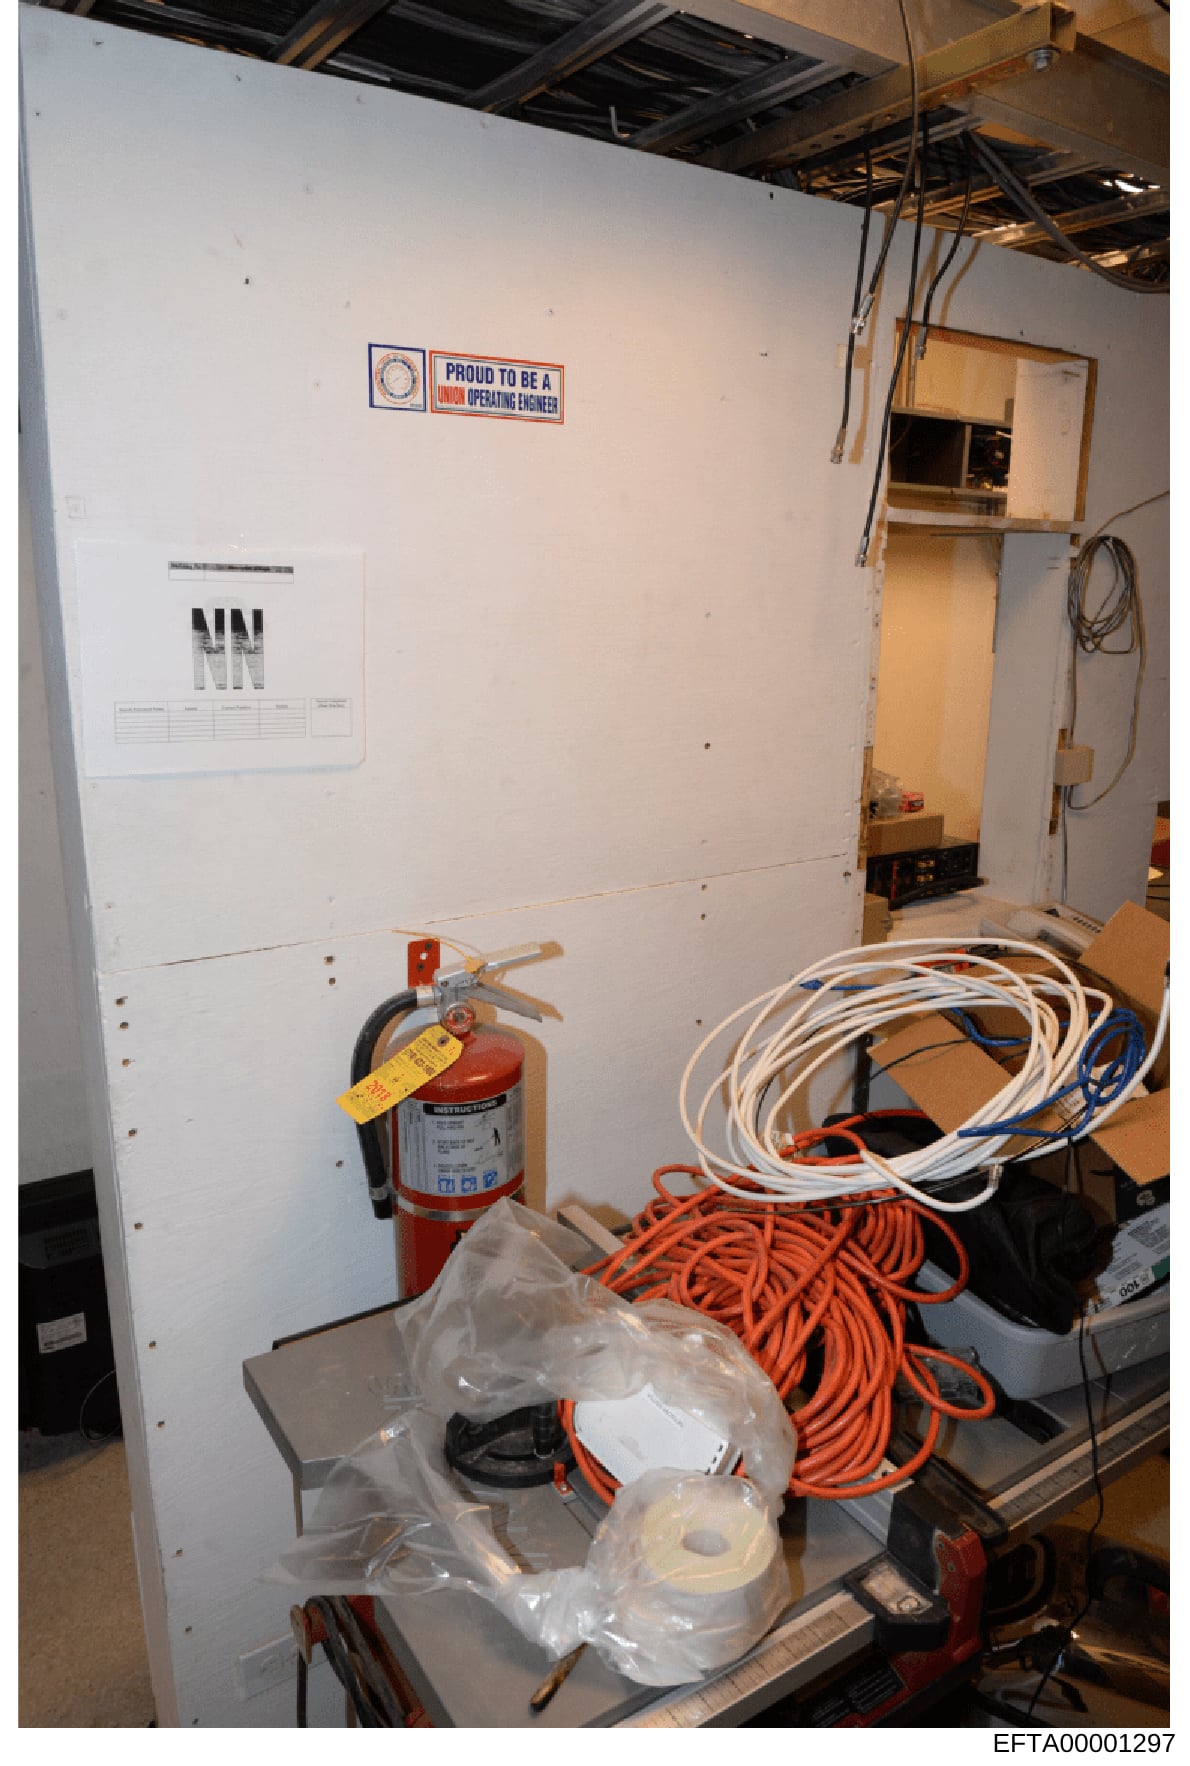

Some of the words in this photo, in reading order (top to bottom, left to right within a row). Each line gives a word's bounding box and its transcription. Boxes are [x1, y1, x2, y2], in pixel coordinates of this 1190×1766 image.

[446, 362, 494, 384] PROUD
[499, 368, 516, 387] TO
[521, 370, 538, 389] BE
[542, 373, 551, 390] A
[438, 385, 465, 405] UNION
[468, 389, 516, 410] OPERATING
[518, 392, 558, 413] ENGINEER
[192, 608, 264, 690] NN
[433, 1100, 498, 1114] INSTRUCTIONS
